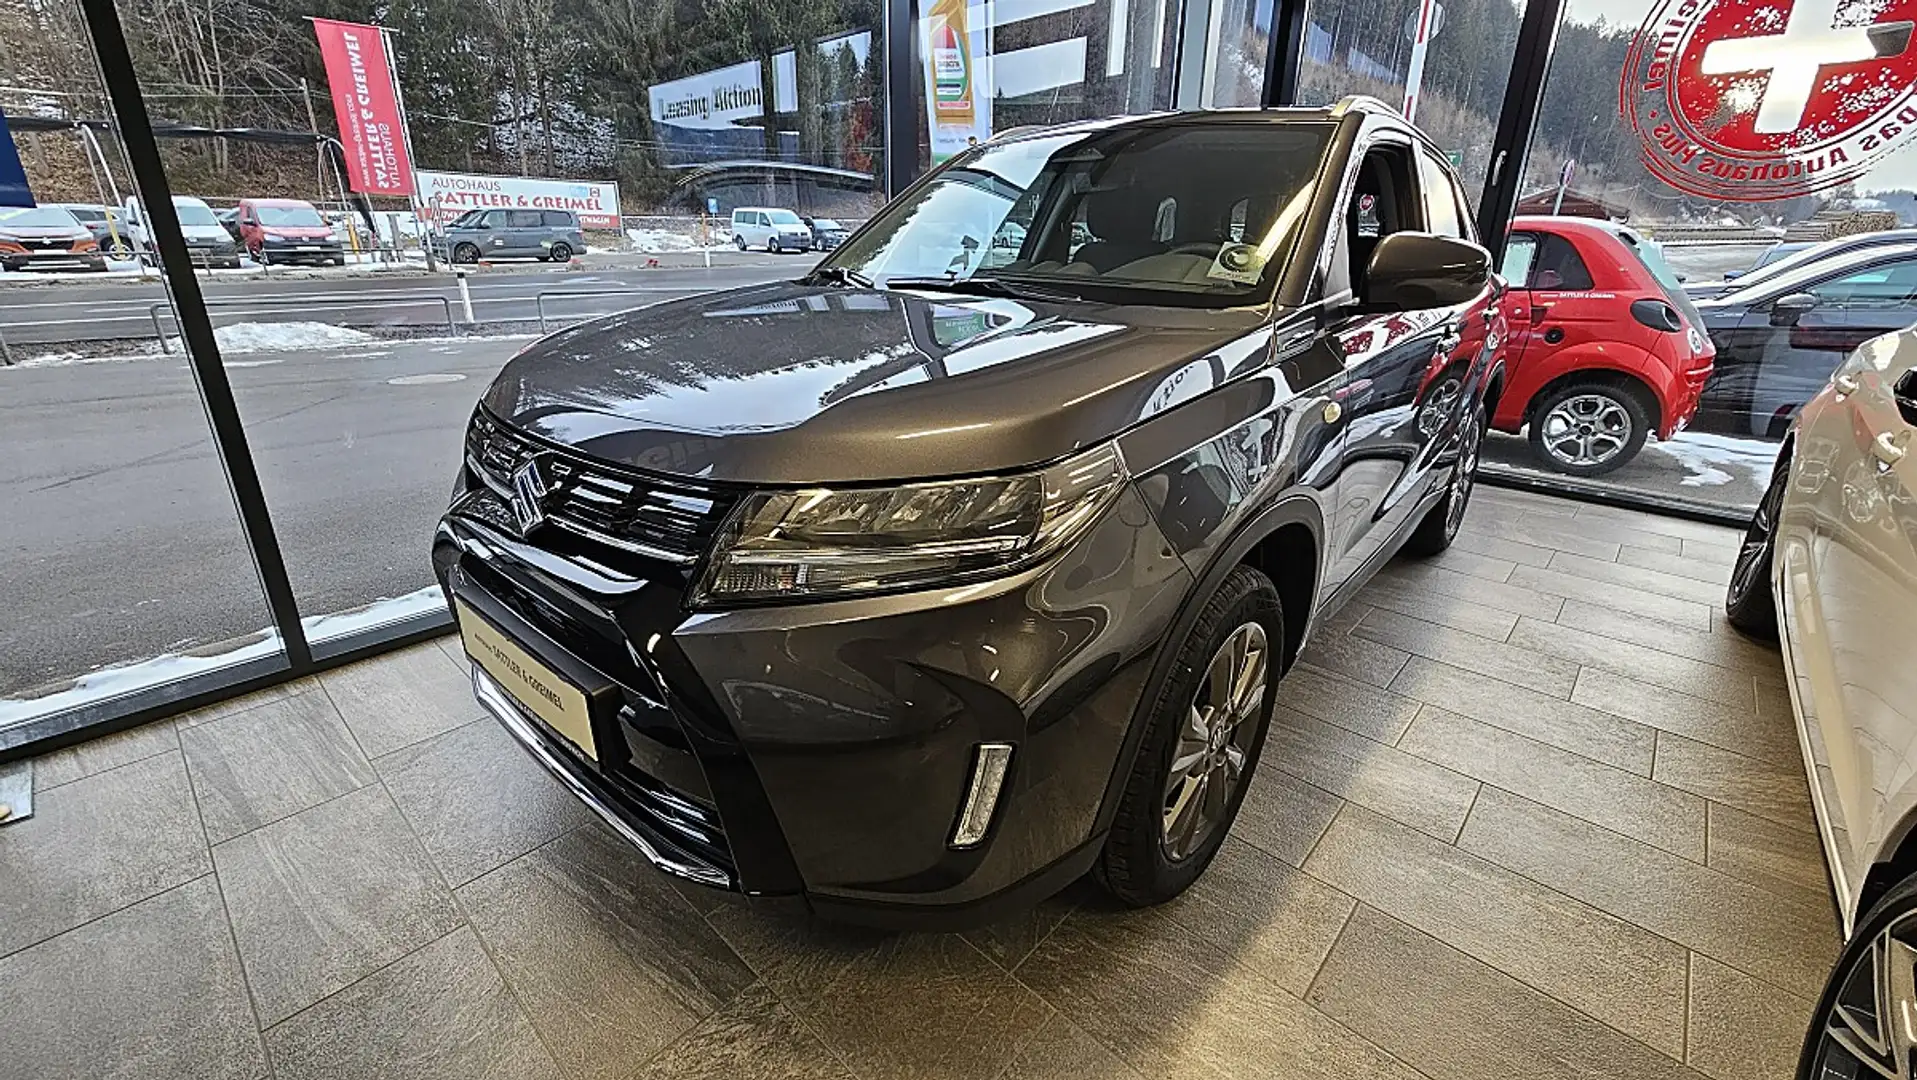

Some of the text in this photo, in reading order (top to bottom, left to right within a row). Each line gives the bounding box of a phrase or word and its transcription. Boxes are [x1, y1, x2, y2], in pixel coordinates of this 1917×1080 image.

[431, 177, 501, 192] AUTOHAUS
[434, 190, 603, 211] SATTLER & GREIMEL
